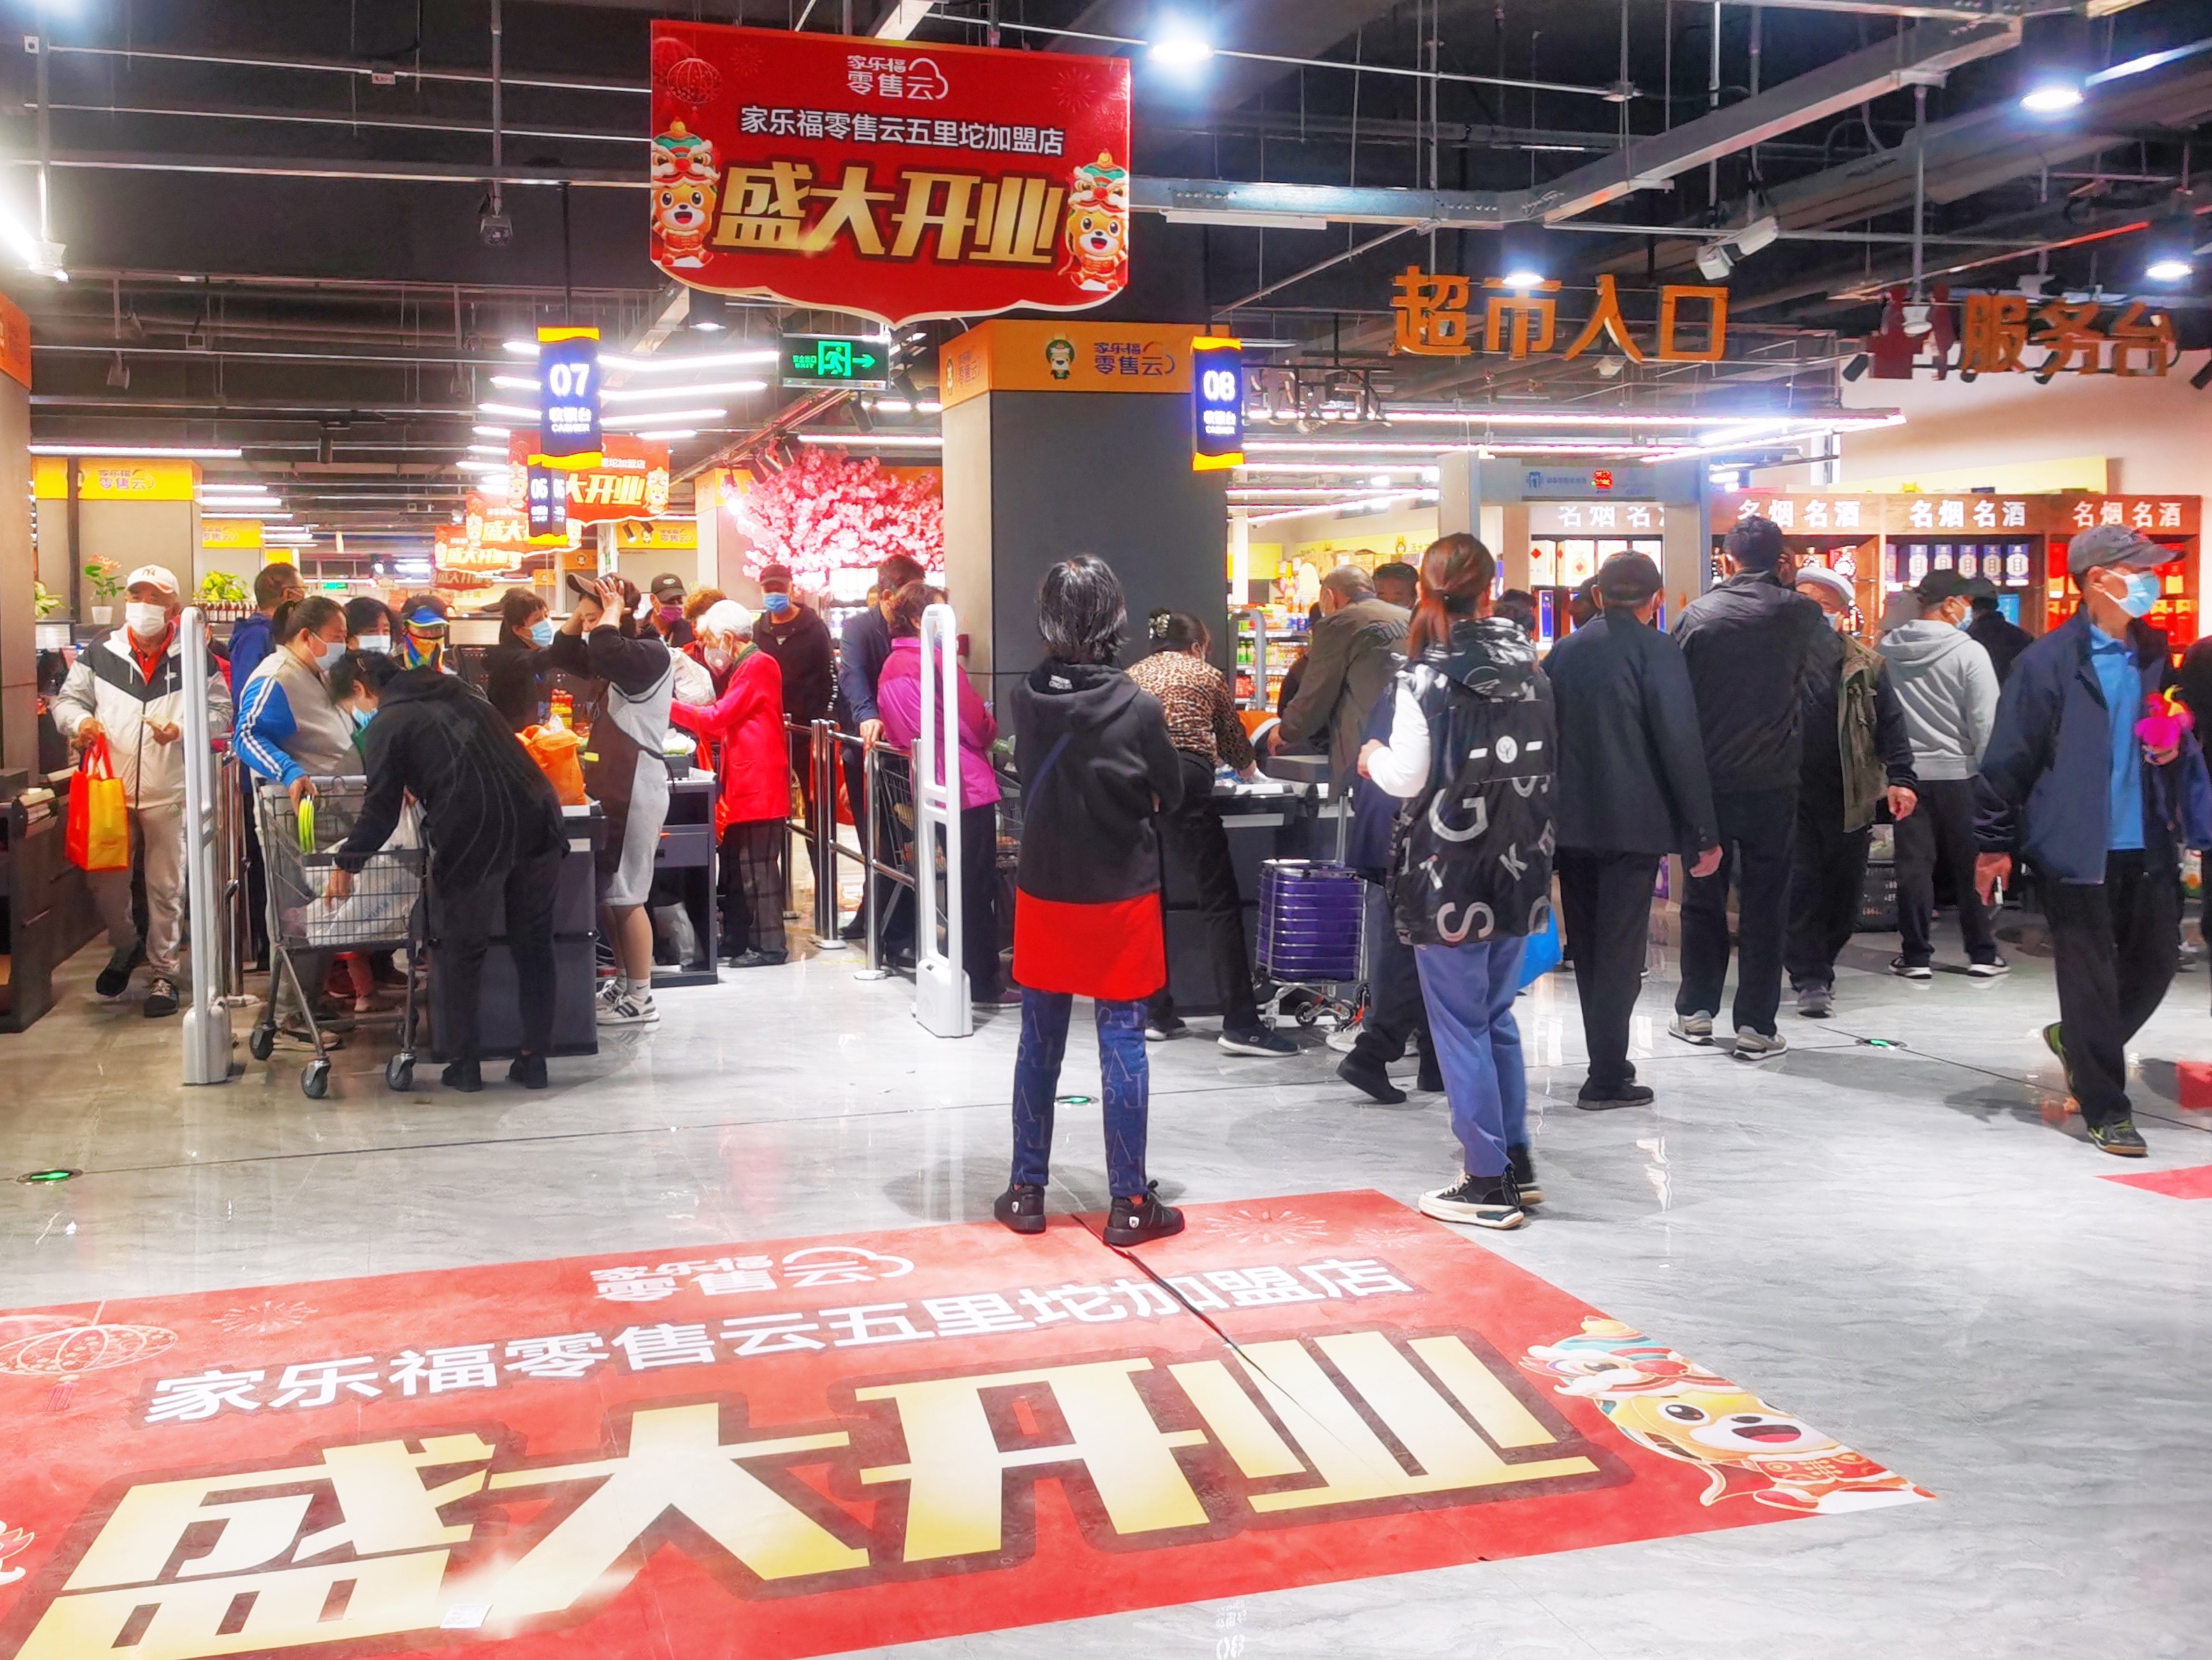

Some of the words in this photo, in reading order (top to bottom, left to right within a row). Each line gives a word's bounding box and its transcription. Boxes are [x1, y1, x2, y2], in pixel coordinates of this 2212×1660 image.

[847, 54, 906, 73] 家乐福
[846, 71, 935, 101] 零售云
[739, 105, 1064, 156] 家乐福零售云五里坨加盟店
[711, 161, 1064, 264] 盛大开业
[1389, 265, 1729, 365] 超市入口
[1960, 294, 2174, 377] 服务台
[549, 363, 590, 398] 07
[1095, 355, 1163, 376] 零售云
[1203, 370, 1236, 402] 08
[531, 477, 548, 500] 06
[553, 478, 566, 500] 06
[1557, 505, 1664, 528] 名烟名
[1909, 499, 2026, 528] 名烟名酒
[2072, 500, 2183, 527] 名烟名酒
[593, 1260, 877, 1302] 零售云
[144, 1258, 1413, 1424] 家乐福零售云五里坨加盟店
[12, 1331, 1601, 1660] 盛大开业
